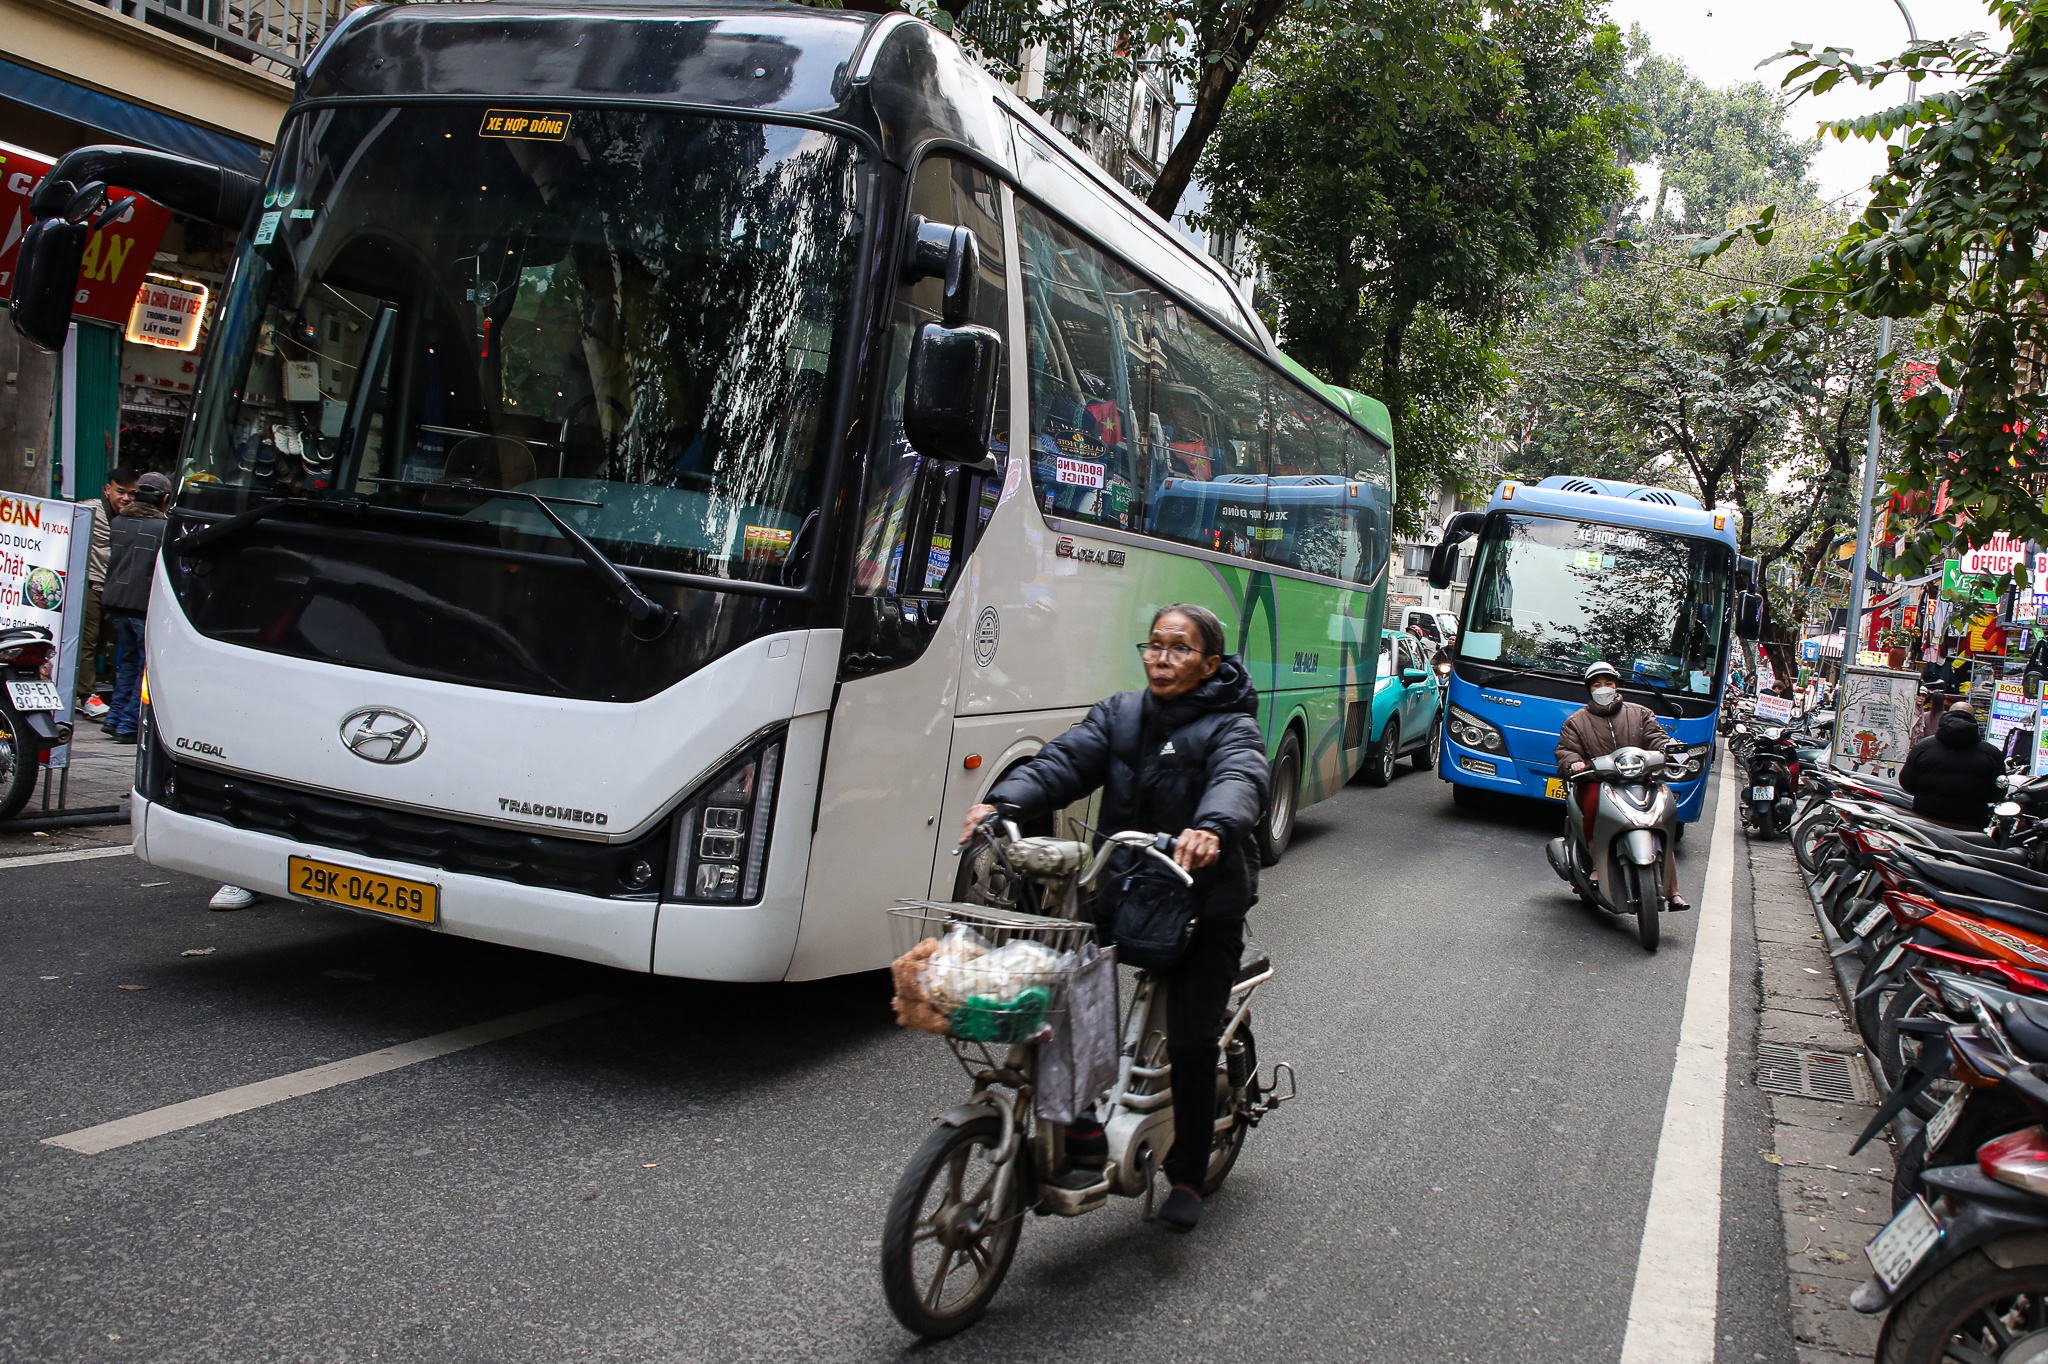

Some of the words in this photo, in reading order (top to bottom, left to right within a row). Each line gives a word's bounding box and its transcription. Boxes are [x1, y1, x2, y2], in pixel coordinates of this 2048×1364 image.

[486, 117, 503, 131] XE
[1577, 528, 1591, 541] XE
[13, 537, 42, 552] DUCK
[1971, 554, 2013, 572] OFFICE
[0, 582, 20, 610] rộn
[1481, 693, 1522, 708] THACO
[1997, 692, 2024, 704] MONEY
[175, 736, 227, 760] GLOBAL
[498, 797, 608, 826] TRACOMECO
[300, 865, 424, 914] 29K-042.69
